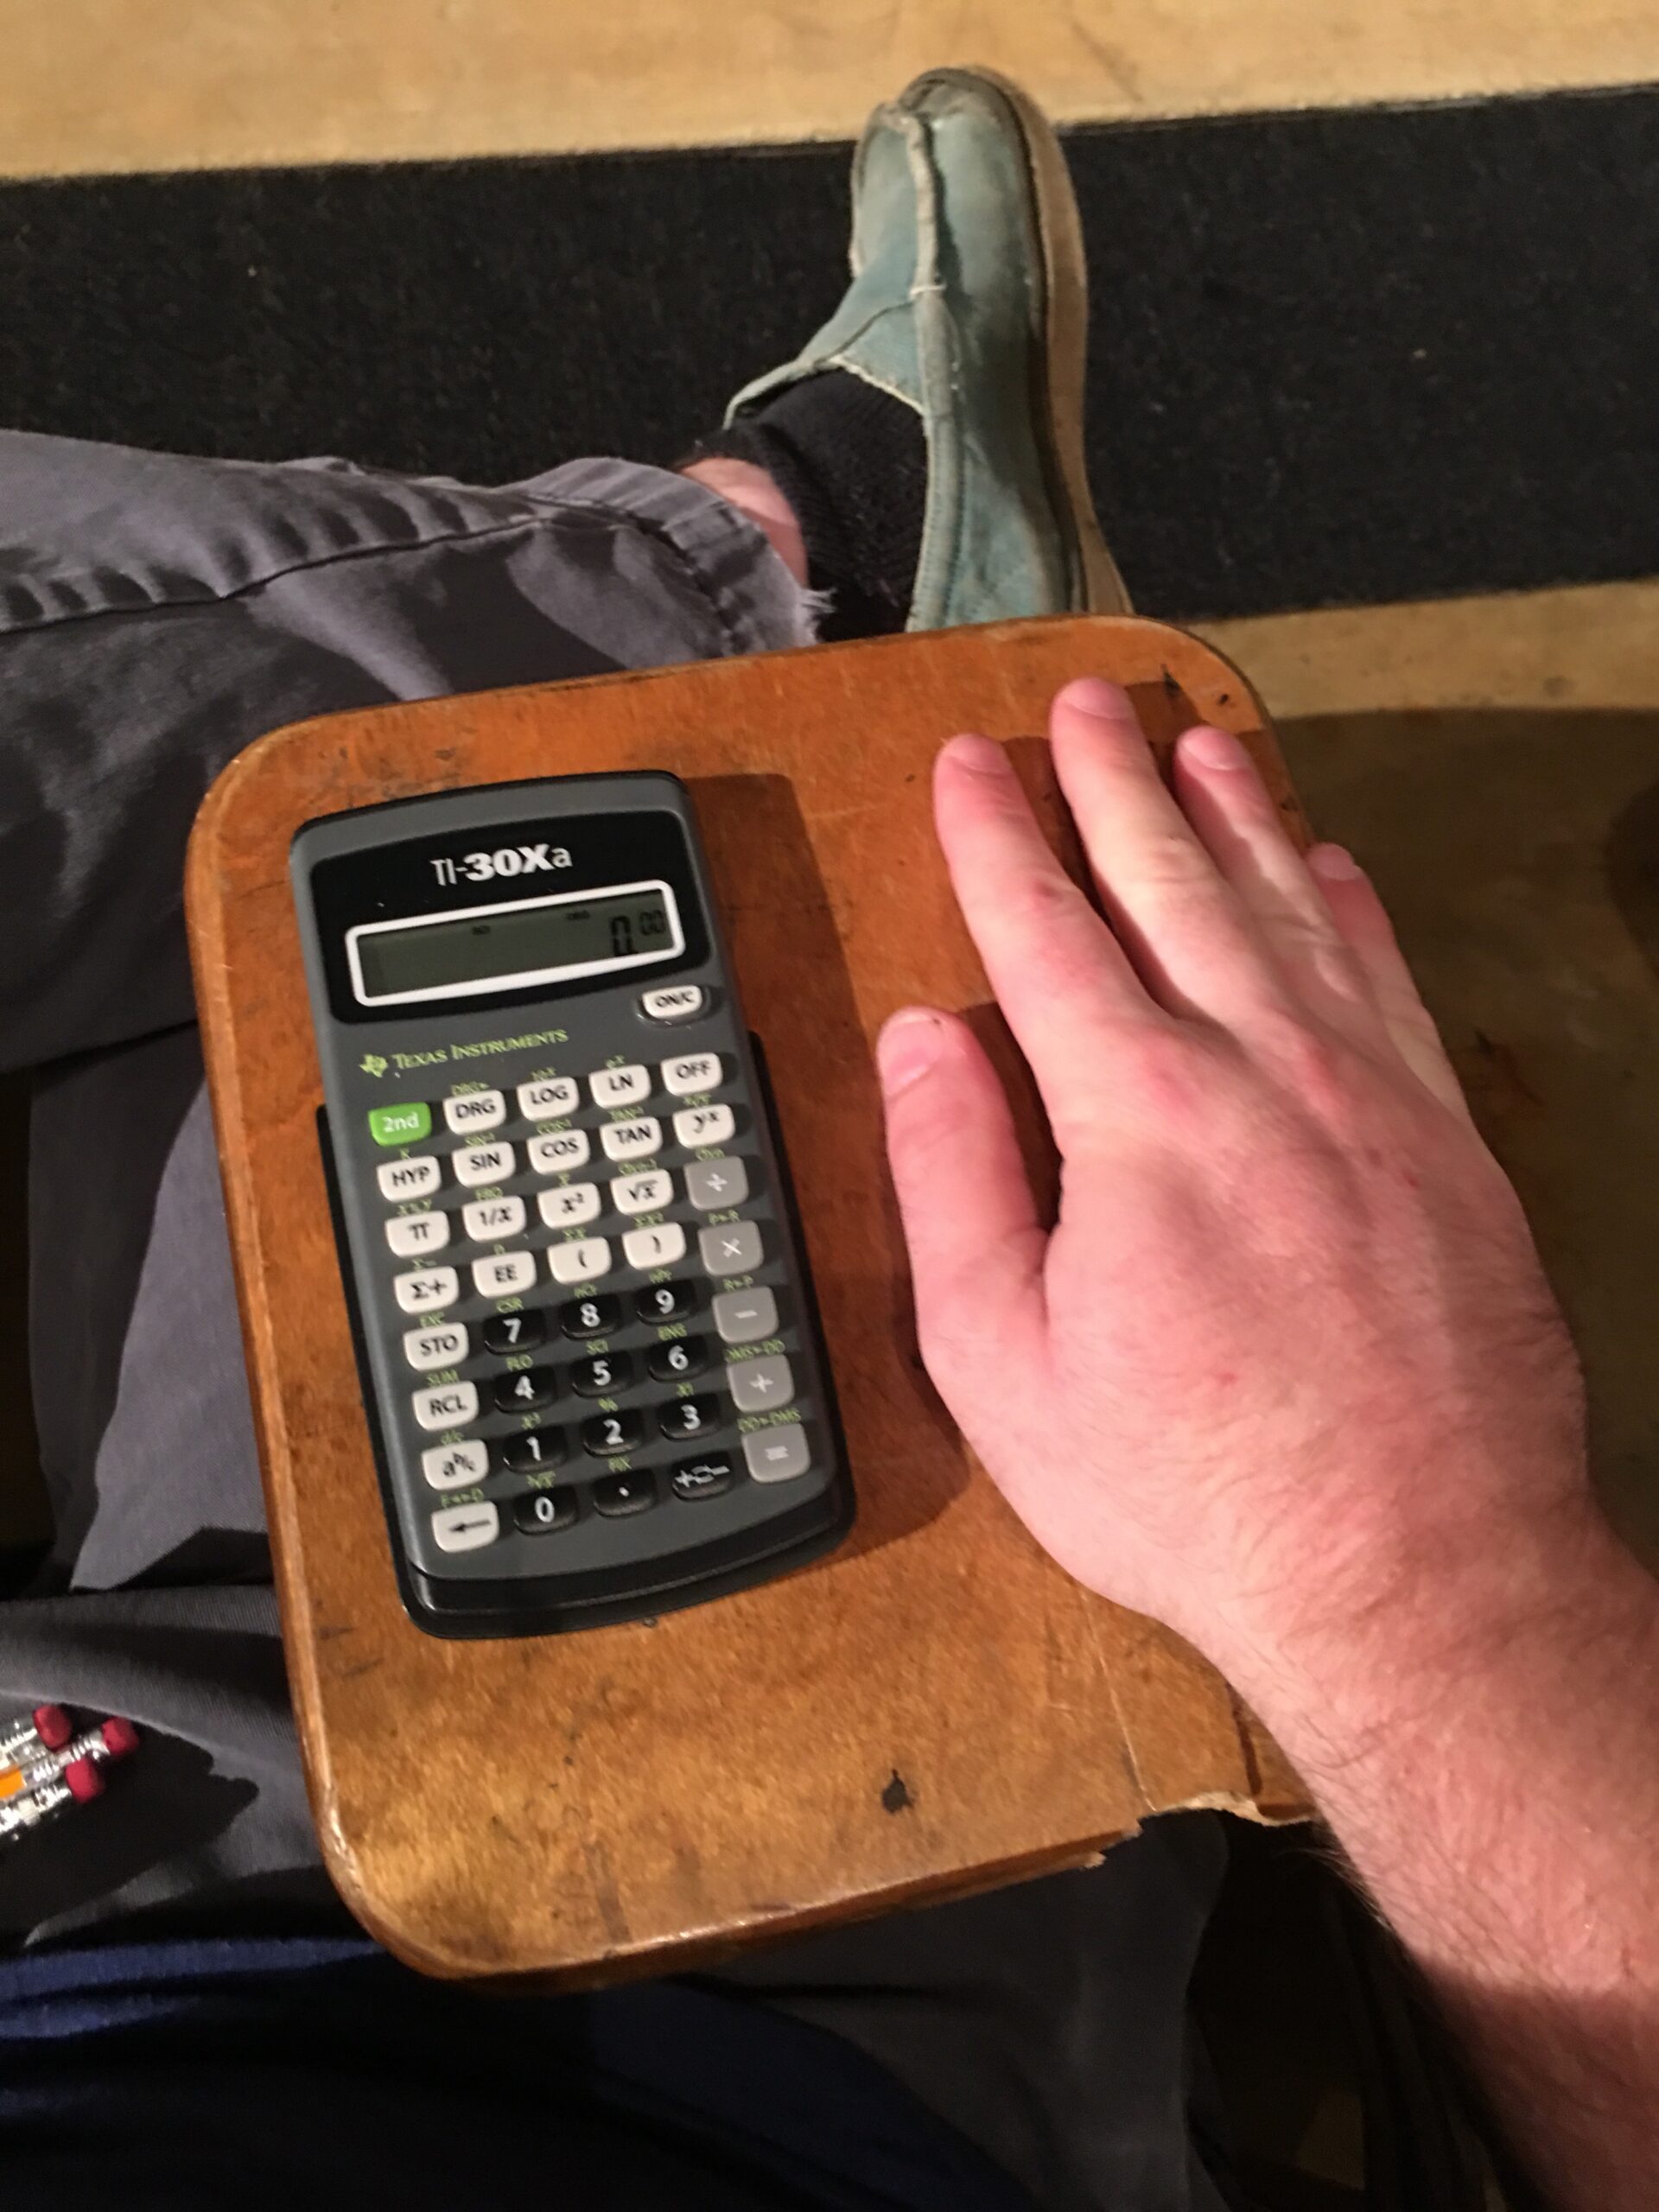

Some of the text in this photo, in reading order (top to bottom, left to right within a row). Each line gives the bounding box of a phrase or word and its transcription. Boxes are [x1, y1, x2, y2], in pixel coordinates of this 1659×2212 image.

[430, 843, 573, 886] TI-30Xa
[654, 989, 695, 1008] ON/C
[676, 1059, 711, 1079] OFF
[608, 1073, 634, 1091] LN
[529, 1084, 569, 1105] LOG
[454, 1099, 496, 1119] DRG
[382, 1112, 420, 1133] 2nd
[614, 1126, 653, 1145] TAN
[541, 1138, 580, 1158] COS
[469, 1153, 501, 1171] SIN
[391, 1166, 430, 1188] HYP
[494, 1264, 518, 1283] EE
[655, 1288, 675, 1314] 9
[580, 1303, 601, 1327] 8
[502, 1318, 522, 1344] 7
[419, 1334, 458, 1357] STO
[668, 1344, 689, 1370] 6
[592, 1360, 612, 1386] 5
[514, 1375, 535, 1400] 4
[429, 1394, 467, 1416] RCL
[681, 1404, 701, 1430] 3
[603, 1419, 624, 1445] 2
[526, 1436, 542, 1461] 1
[535, 1497, 555, 1522] 0
